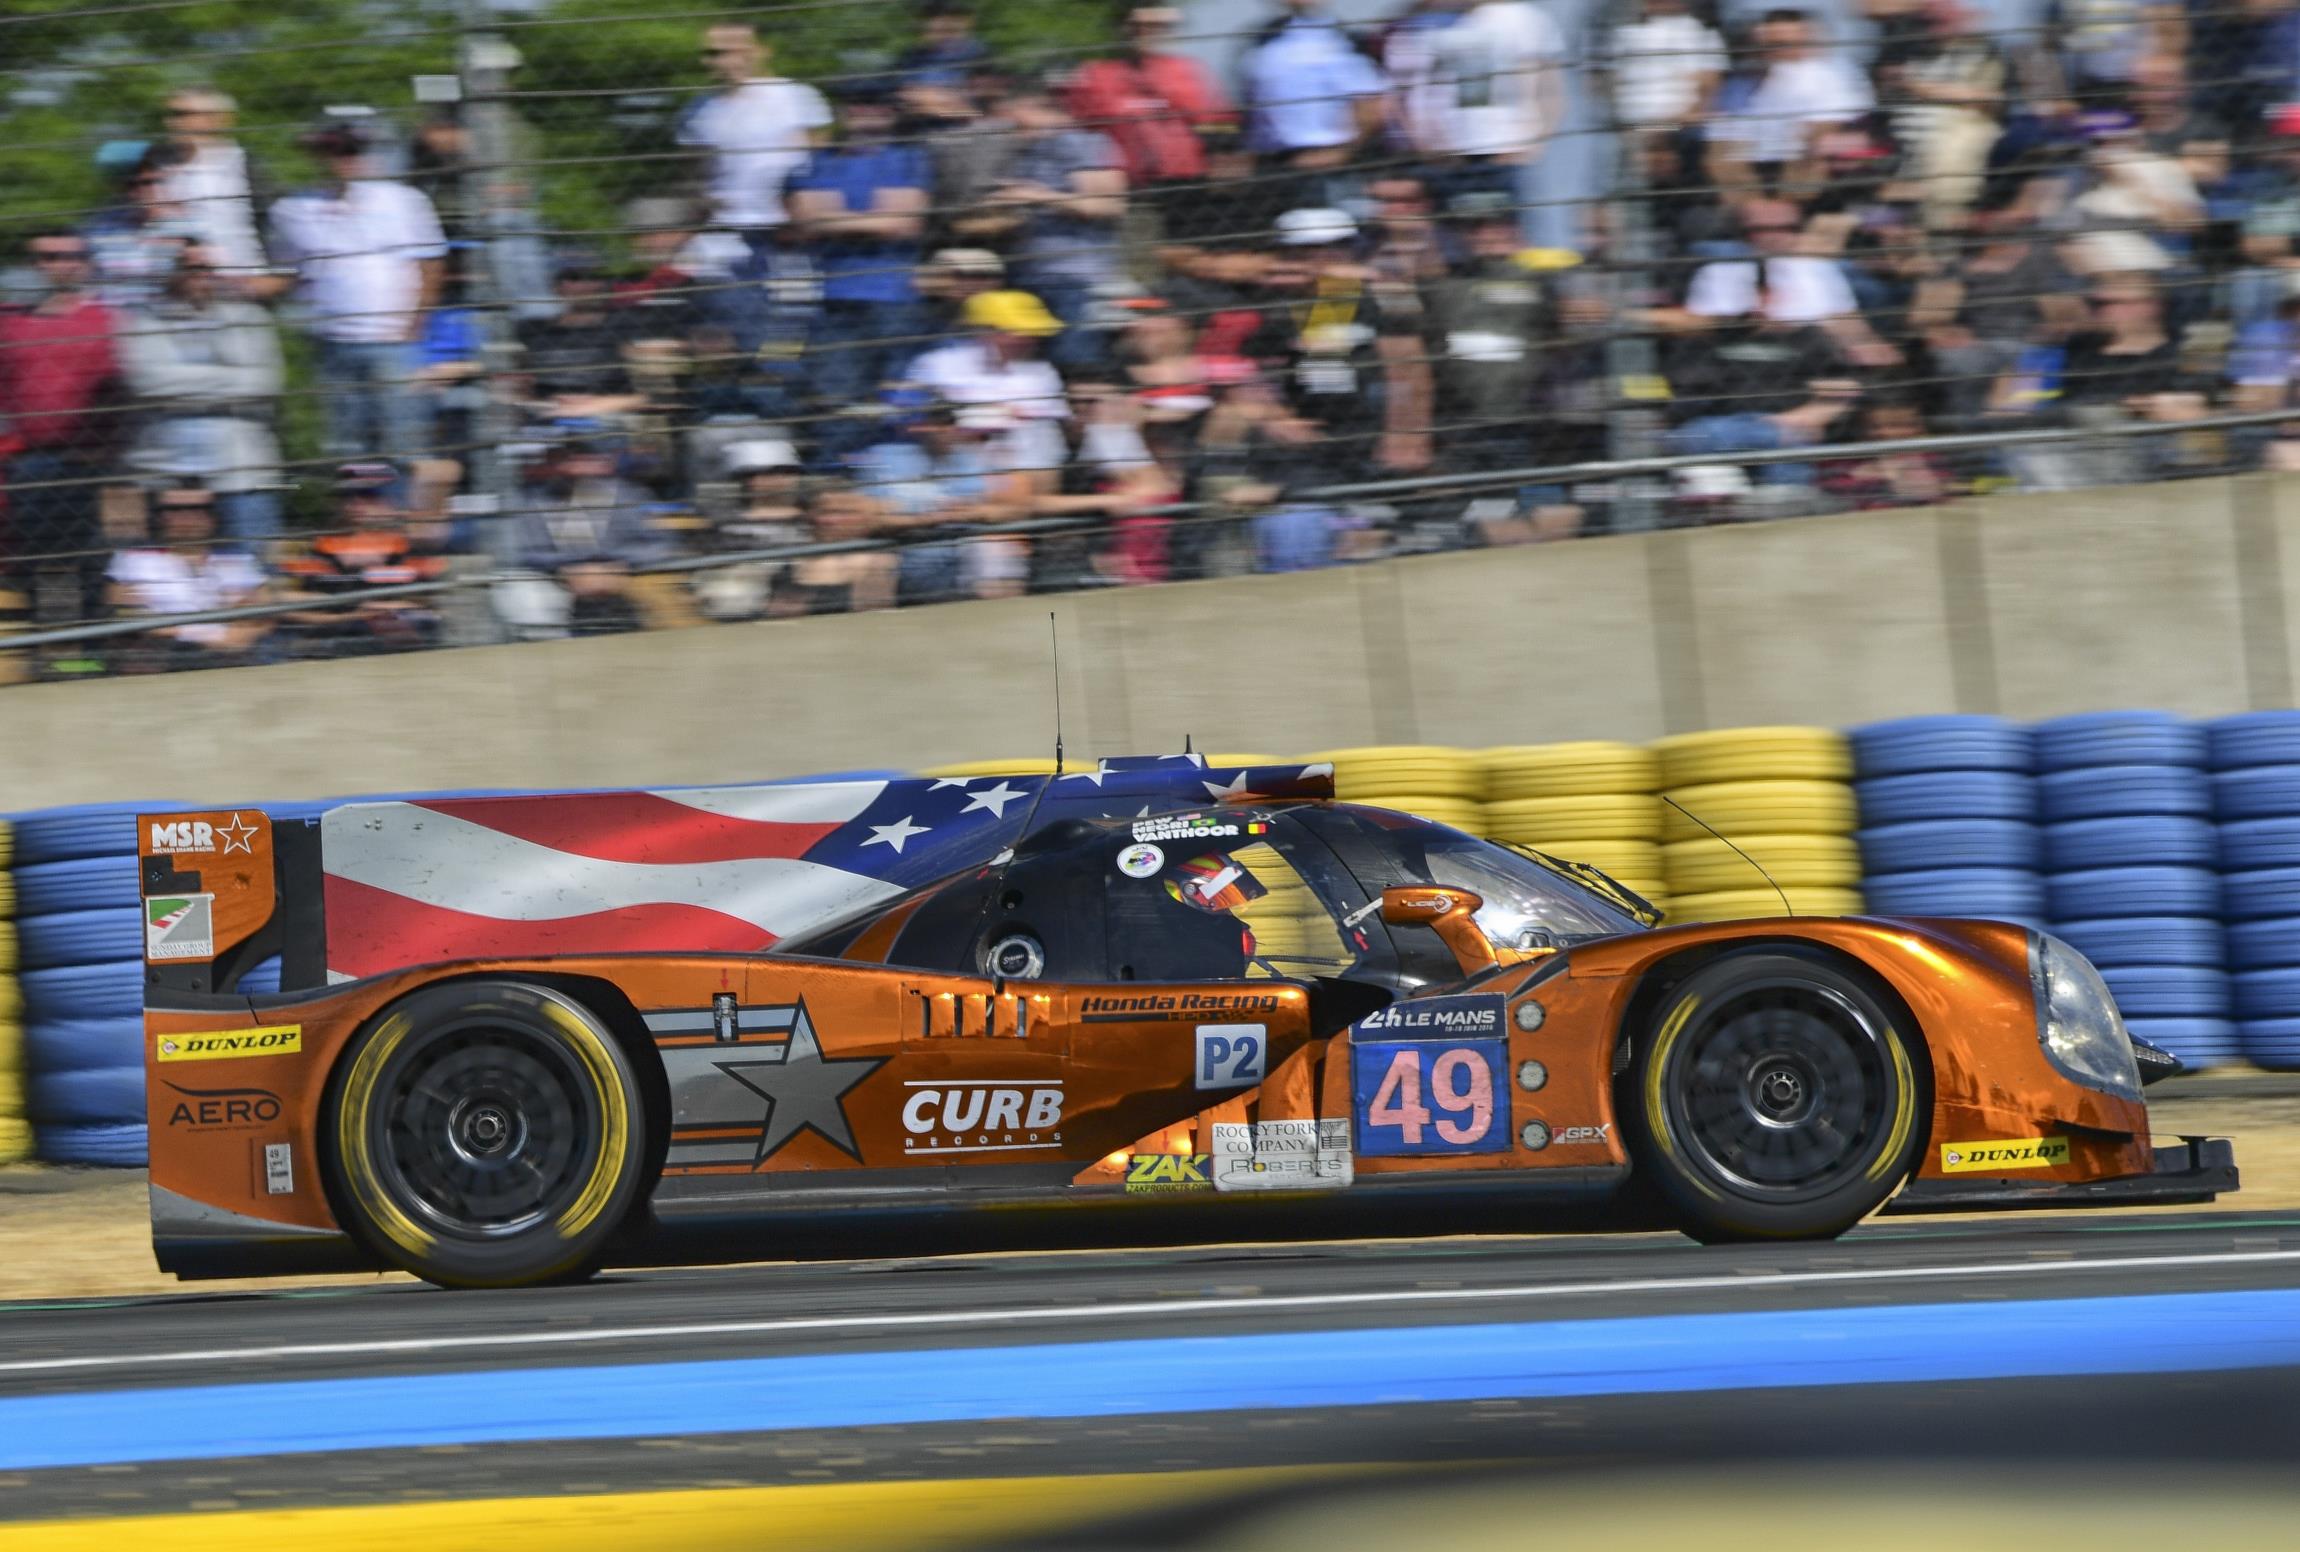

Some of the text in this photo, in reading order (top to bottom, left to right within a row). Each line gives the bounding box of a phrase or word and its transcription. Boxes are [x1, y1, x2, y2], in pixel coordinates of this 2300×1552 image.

[151, 821, 214, 847] MSR
[1132, 825, 1239, 842] VANTHOOR
[1081, 994, 1279, 1013] Honda Racing
[1405, 1012, 1431, 1026] LE
[1434, 1010, 1496, 1025] MANS
[184, 1032, 297, 1052] DUNLOP
[1203, 1036, 1258, 1081] P2
[1369, 1048, 1493, 1144] 49
[169, 1099, 281, 1126] AERO
[902, 1089, 1064, 1133] CURB
[1216, 1122, 1319, 1138] ROCKY FORK
[1566, 1123, 1610, 1139] GPX
[905, 1132, 1061, 1147] RECORDS
[1226, 1139, 1306, 1153] COMPANY
[1968, 1145, 2066, 1162] DUNLOP
[1127, 1154, 1209, 1182] ZAK
[1231, 1160, 1342, 1173] ROBERTS
